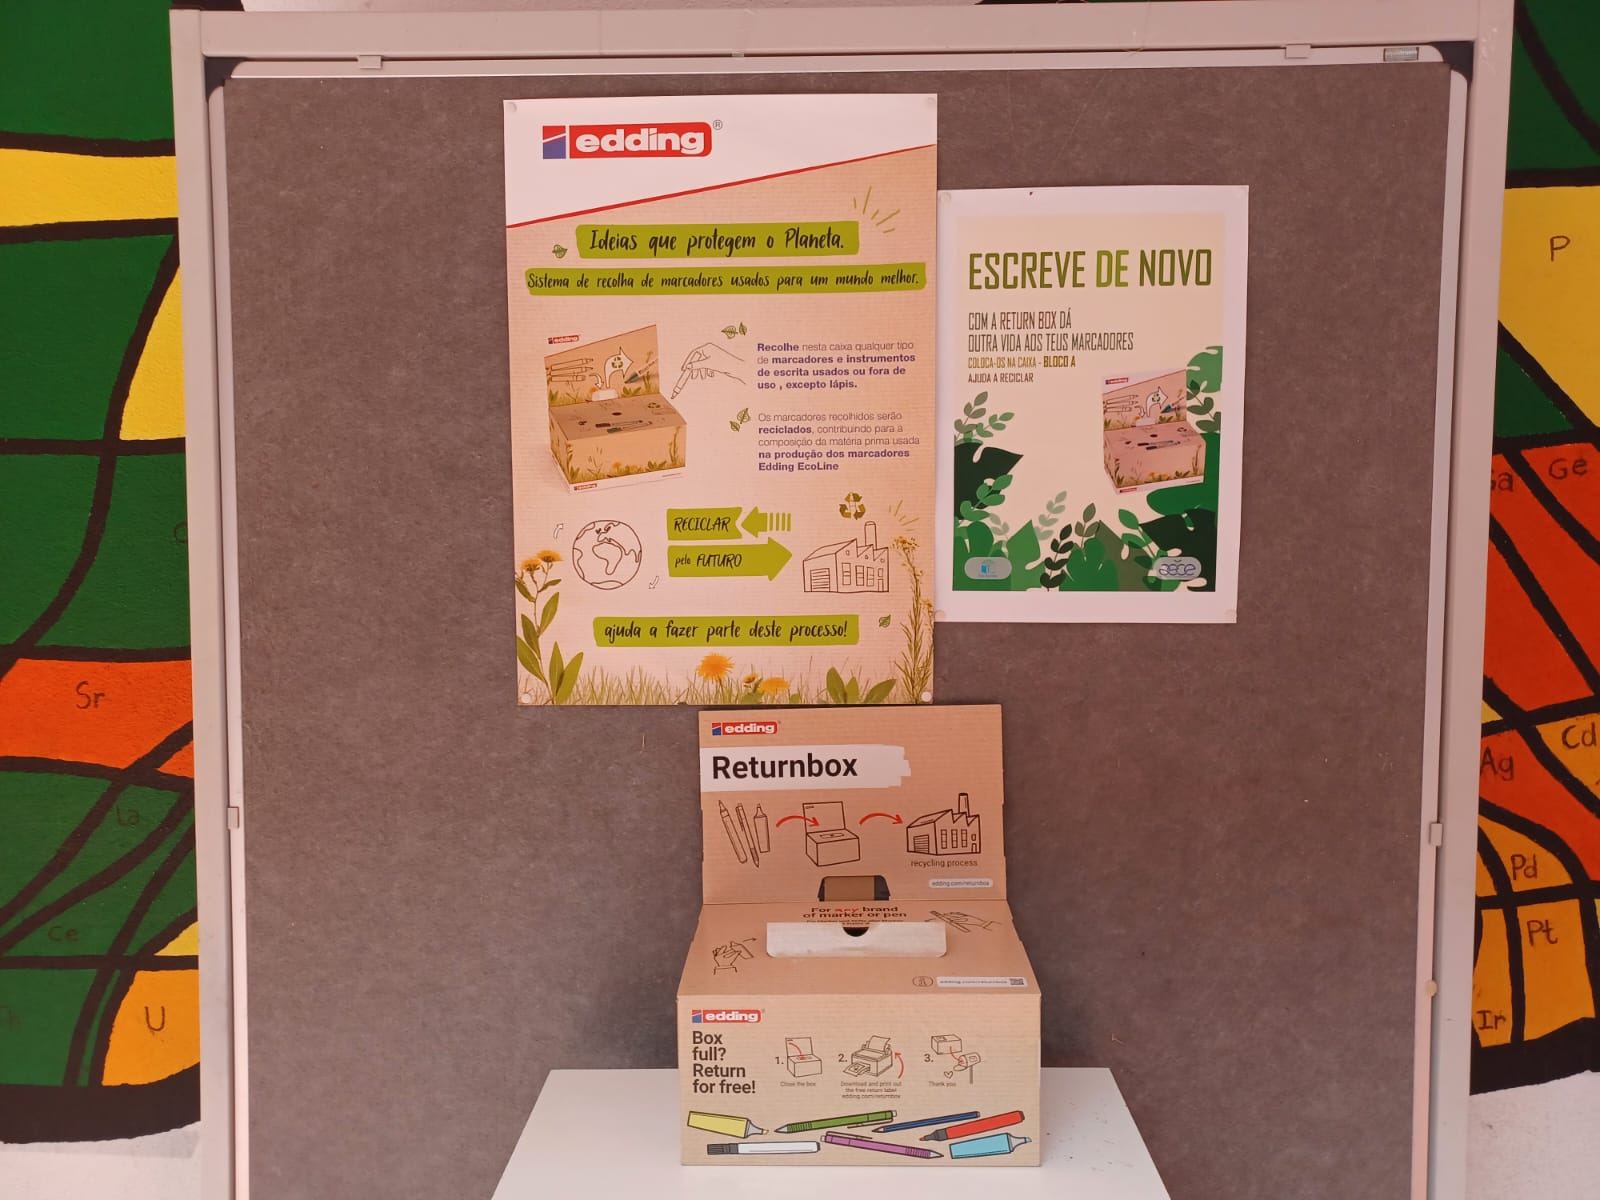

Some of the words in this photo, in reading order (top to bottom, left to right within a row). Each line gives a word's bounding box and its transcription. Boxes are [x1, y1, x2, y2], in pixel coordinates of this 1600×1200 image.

[575, 128, 705, 154] edding
[590, 229, 637, 251] Ideias
[649, 234, 677, 255] que
[686, 230, 755, 257] protegem
[767, 236, 774, 247] o
[785, 226, 844, 248] Planeta.
[1550, 235, 1570, 261] P
[969, 251, 1086, 290] ESCREVE
[1096, 250, 1129, 288] DE
[1139, 249, 1212, 286] NOVO
[527, 272, 569, 289] Sistema
[577, 272, 589, 288] de
[597, 273, 634, 289] recolha
[641, 272, 654, 287] de
[661, 273, 723, 287] marcadores
[730, 272, 770, 287] usados
[777, 275, 802, 291] para
[810, 275, 828, 286] um
[835, 270, 873, 286] mundo
[881, 270, 919, 285] melhor.
[968, 311, 988, 331] COM
[991, 311, 997, 330] A
[1000, 311, 1035, 330] RETURN
[1038, 311, 1057, 329] BOX
[1060, 308, 1071, 328] DÁ
[758, 343, 799, 351] Recolhe
[802, 343, 826, 351] nesta
[855, 342, 894, 352] qualquer
[897, 342, 913, 352] tipo
[968, 334, 997, 353] OUTRA
[1001, 333, 1022, 352] VIDA
[1025, 333, 1043, 352] AOS
[1046, 333, 1068, 351] TEUS
[1071, 332, 1133, 351] MARCADORES
[757, 356, 769, 364] de
[772, 355, 833, 363] marcadores
[846, 354, 915, 362] instrumentos
[968, 357, 1005, 369] COLOCA-OS
[1007, 357, 1015, 368] NA
[1018, 356, 1036, 368] CAIXA
[1043, 356, 1068, 367] BLOCO
[1071, 356, 1076, 367] A
[758, 368, 770, 376] de
[774, 368, 809, 376] escrita
[968, 373, 991, 383] AJUDA
[993, 373, 998, 382] A
[1000, 373, 1034, 382] RECICLAR
[786, 381, 826, 391] excepto
[830, 379, 857, 390] lápis.
[758, 413, 771, 421] Os
[774, 413, 826, 421] marcadores
[877, 412, 902, 420] serão
[759, 426, 814, 434] reciclados,
[817, 425, 871, 433] contribuindo
[875, 426, 895, 434] para
[758, 438, 812, 448] composição
[816, 438, 826, 446] da
[830, 437, 862, 445] matéria
[865, 437, 889, 447] prima
[892, 437, 920, 445] usada
[775, 450, 823, 460] produção
[848, 449, 910, 457] marcadores
[759, 462, 794, 472] Edding
[798, 462, 839, 470] EcoLine
[1548, 458, 1588, 481] Ge
[674, 515, 731, 532] RECICLAR
[675, 555, 691, 566] pelo
[697, 553, 742, 567] FUTURO
[604, 621, 641, 643] ajuda
[649, 626, 657, 638] a
[666, 621, 698, 637] fazer
[706, 620, 741, 642] parte
[749, 619, 782, 638] deste
[790, 619, 847, 642] processo!
[75, 681, 105, 709] Sr
[724, 723, 775, 734] edding
[1562, 722, 1597, 750] Cd
[713, 753, 858, 779] Returnbox
[1480, 747, 1514, 781] Ag
[911, 859, 945, 868] recycling
[947, 860, 978, 868] process
[1510, 854, 1537, 880] Pd
[1526, 919, 1558, 946] Pt
[145, 1006, 165, 1032] U
[705, 1012, 758, 1022] edding
[693, 1031, 722, 1044] Box
[693, 1047, 726, 1061] full?
[838, 1054, 847, 1062] 2.
[924, 1054, 933, 1062] 3.
[693, 1064, 746, 1077] Return
[693, 1080, 715, 1093] for
[720, 1080, 755, 1093] free!
